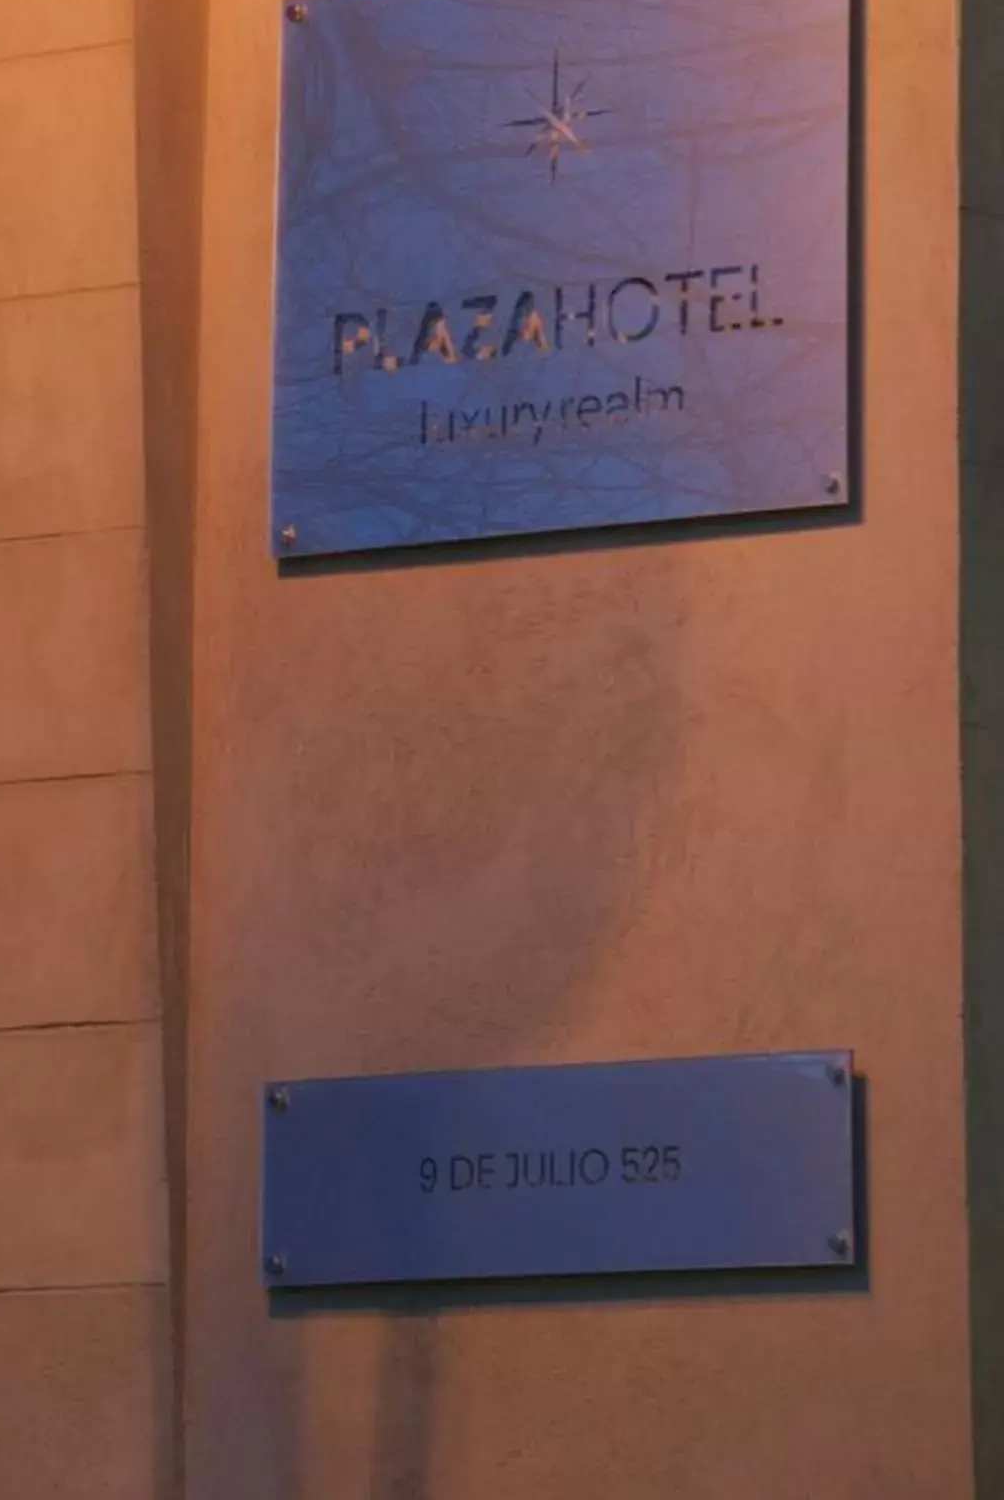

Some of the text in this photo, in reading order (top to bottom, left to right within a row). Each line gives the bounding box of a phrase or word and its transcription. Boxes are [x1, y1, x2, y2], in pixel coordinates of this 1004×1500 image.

[420, 1145, 682, 1193] 9 DE JULIO 525
